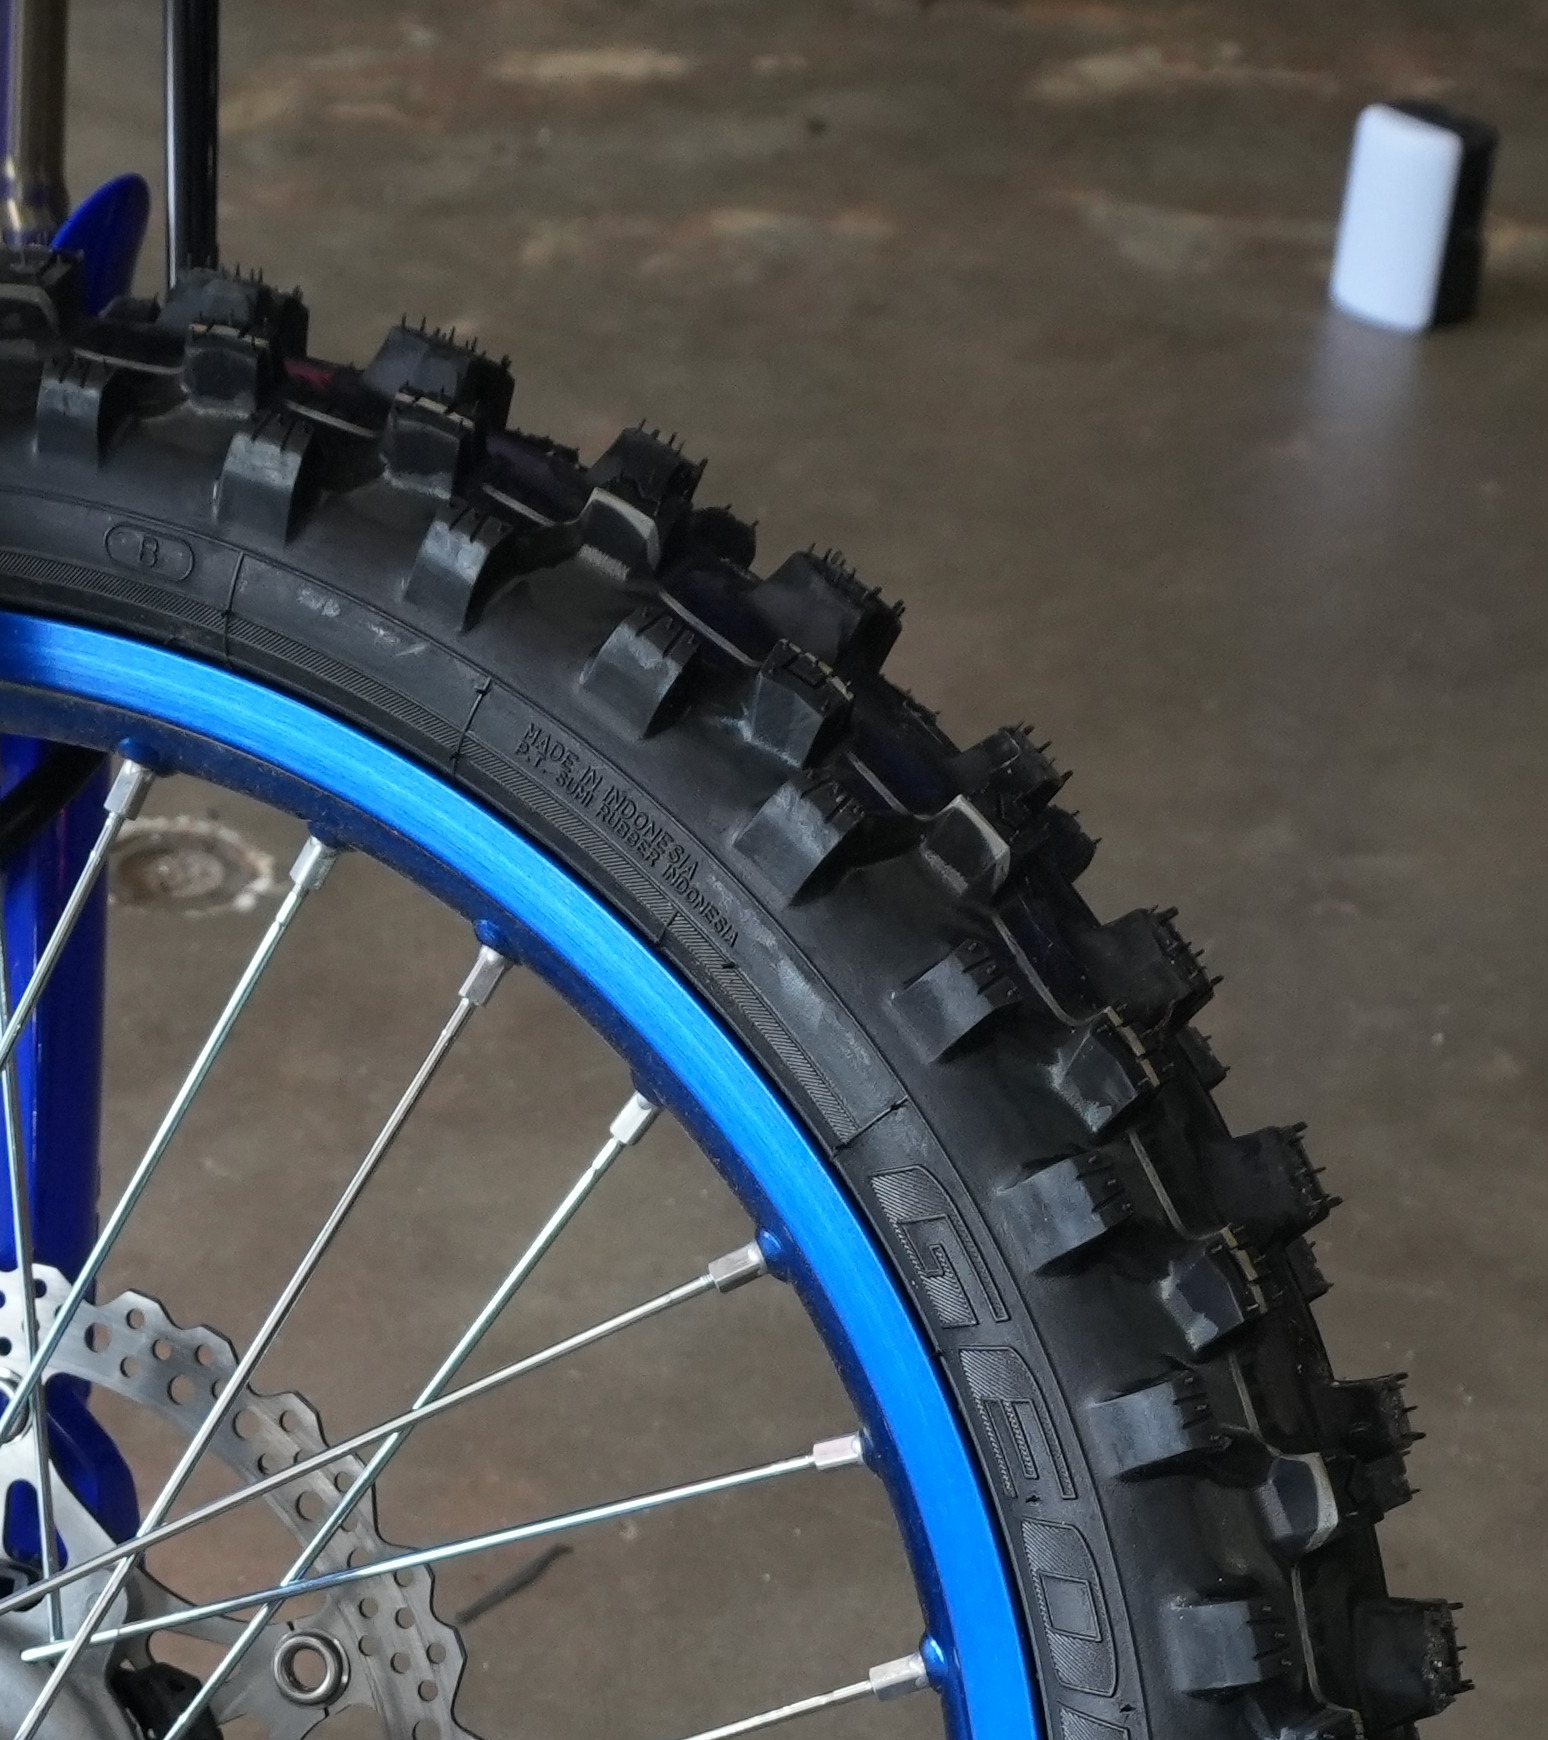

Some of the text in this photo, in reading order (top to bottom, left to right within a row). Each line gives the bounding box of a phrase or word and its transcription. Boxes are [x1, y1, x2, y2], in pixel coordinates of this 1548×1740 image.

[522, 722, 700, 882] MADE IN INDONESIA
[556, 770, 595, 808] SUMI
[595, 804, 661, 868] RUBBER
[661, 864, 741, 948] INDONESIA
